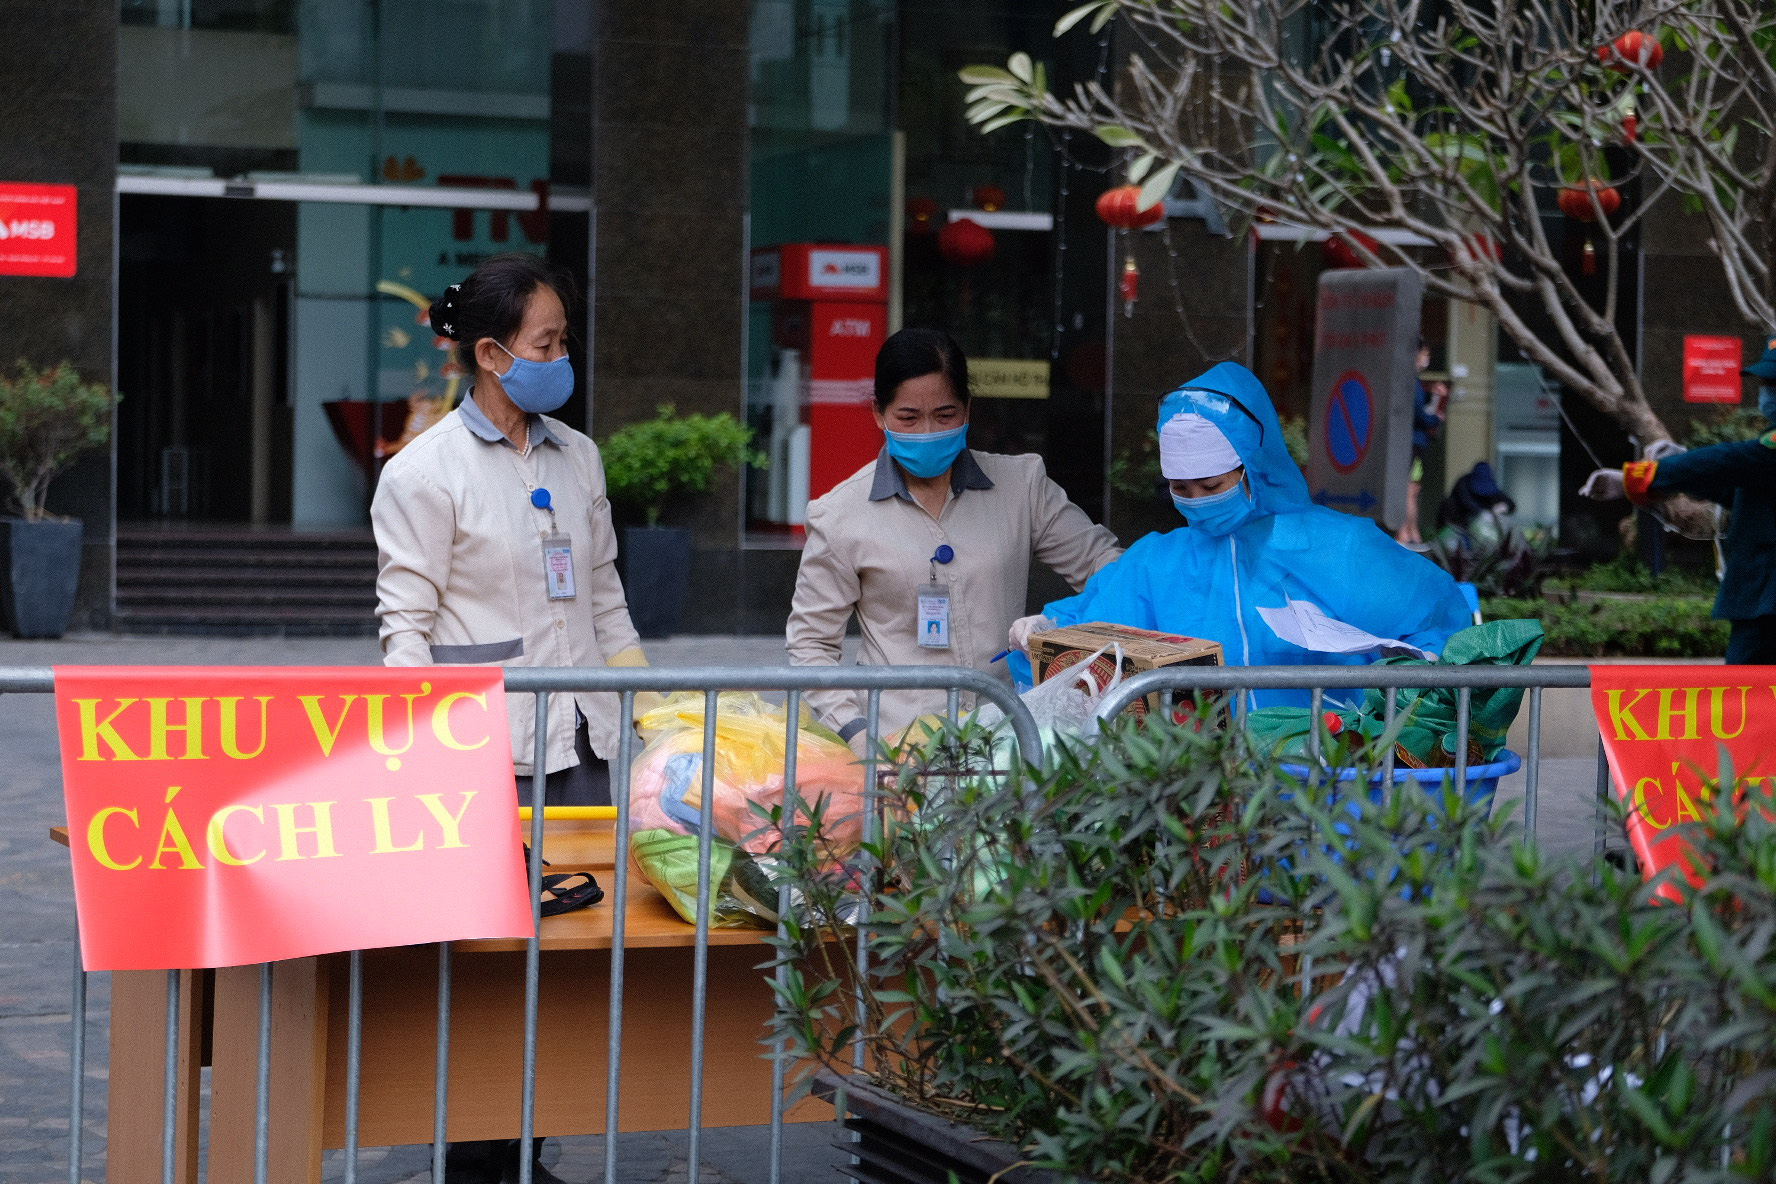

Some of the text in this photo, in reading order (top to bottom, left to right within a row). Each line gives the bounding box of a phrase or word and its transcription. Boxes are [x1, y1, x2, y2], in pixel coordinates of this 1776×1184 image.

[10, 220, 55, 240] MSB
[830, 317, 871, 337] ATM
[71, 682, 491, 772] KHU VỰC
[1603, 686, 1753, 741] KHU
[86, 786, 479, 871] CÁCH LY
